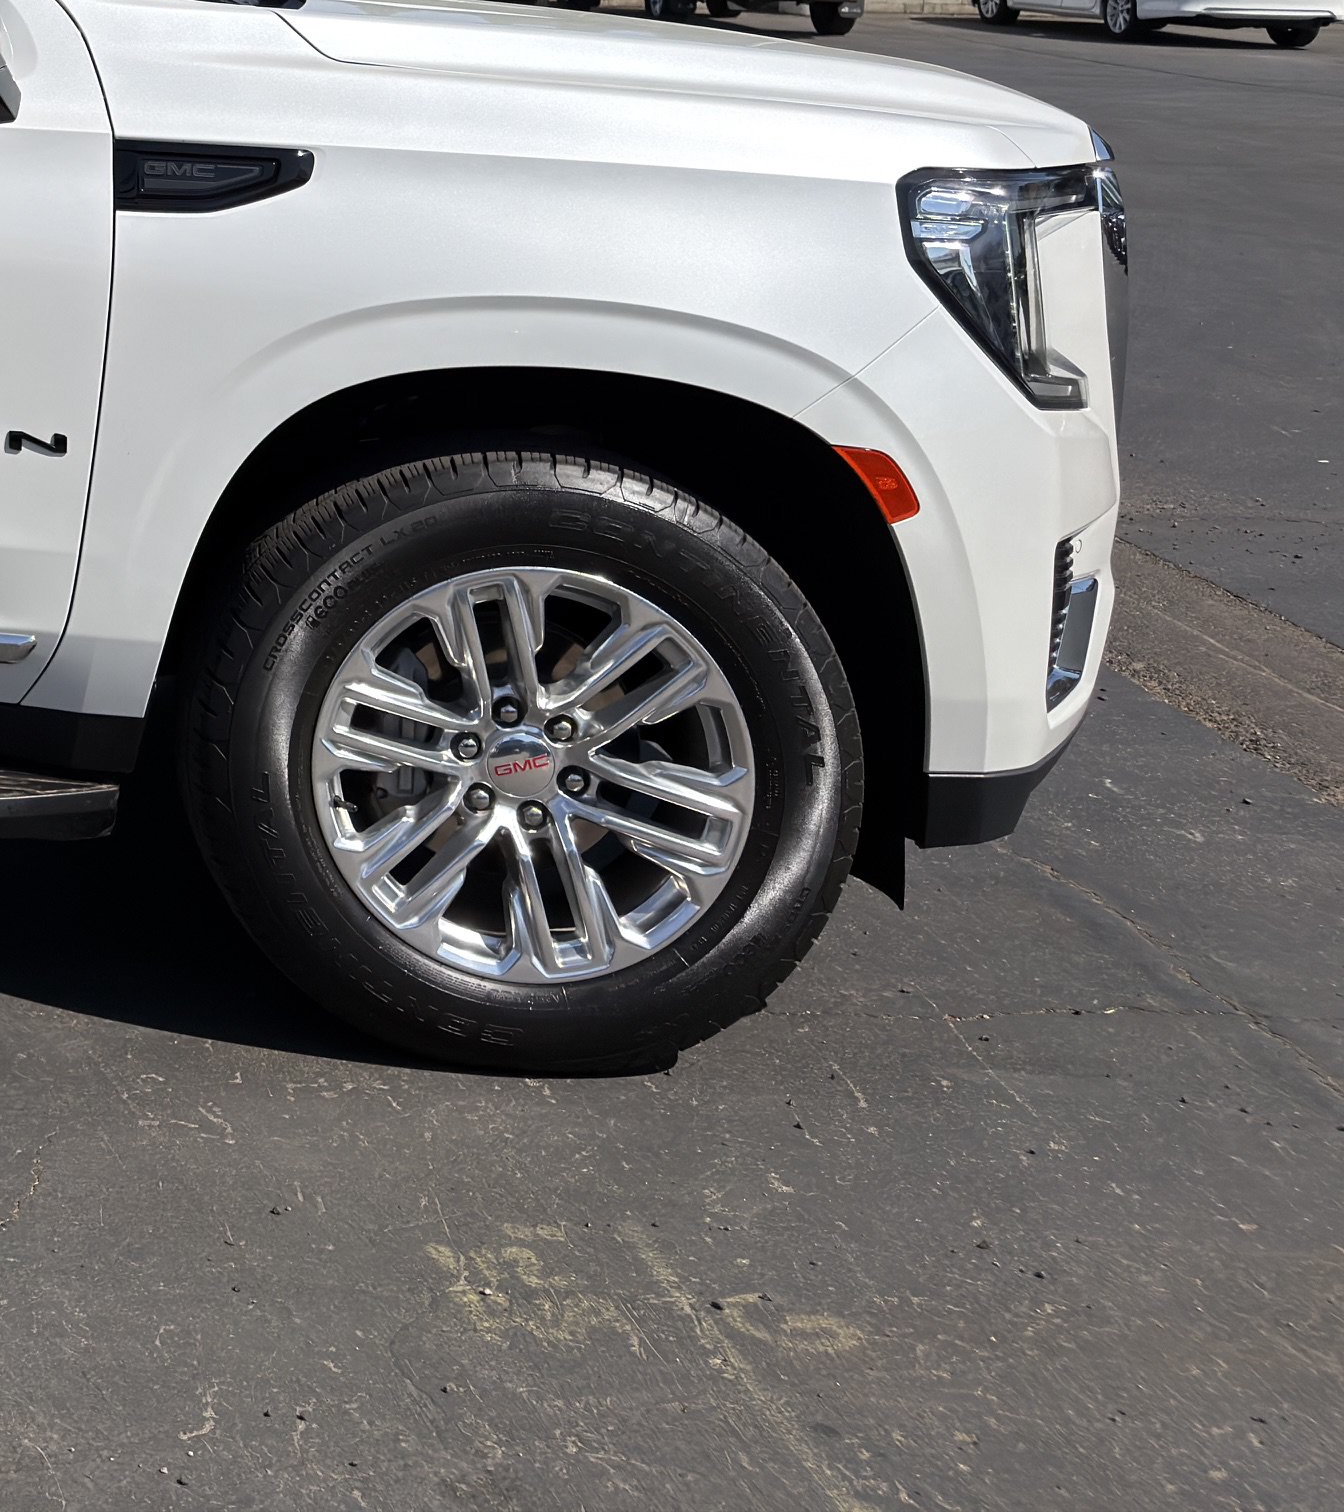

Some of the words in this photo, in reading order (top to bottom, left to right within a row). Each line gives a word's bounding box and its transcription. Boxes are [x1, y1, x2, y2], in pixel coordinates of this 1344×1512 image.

[143, 160, 216, 178] GMC
[263, 543, 375, 672] CROSSCONTACT
[494, 753, 550, 777] GMC
